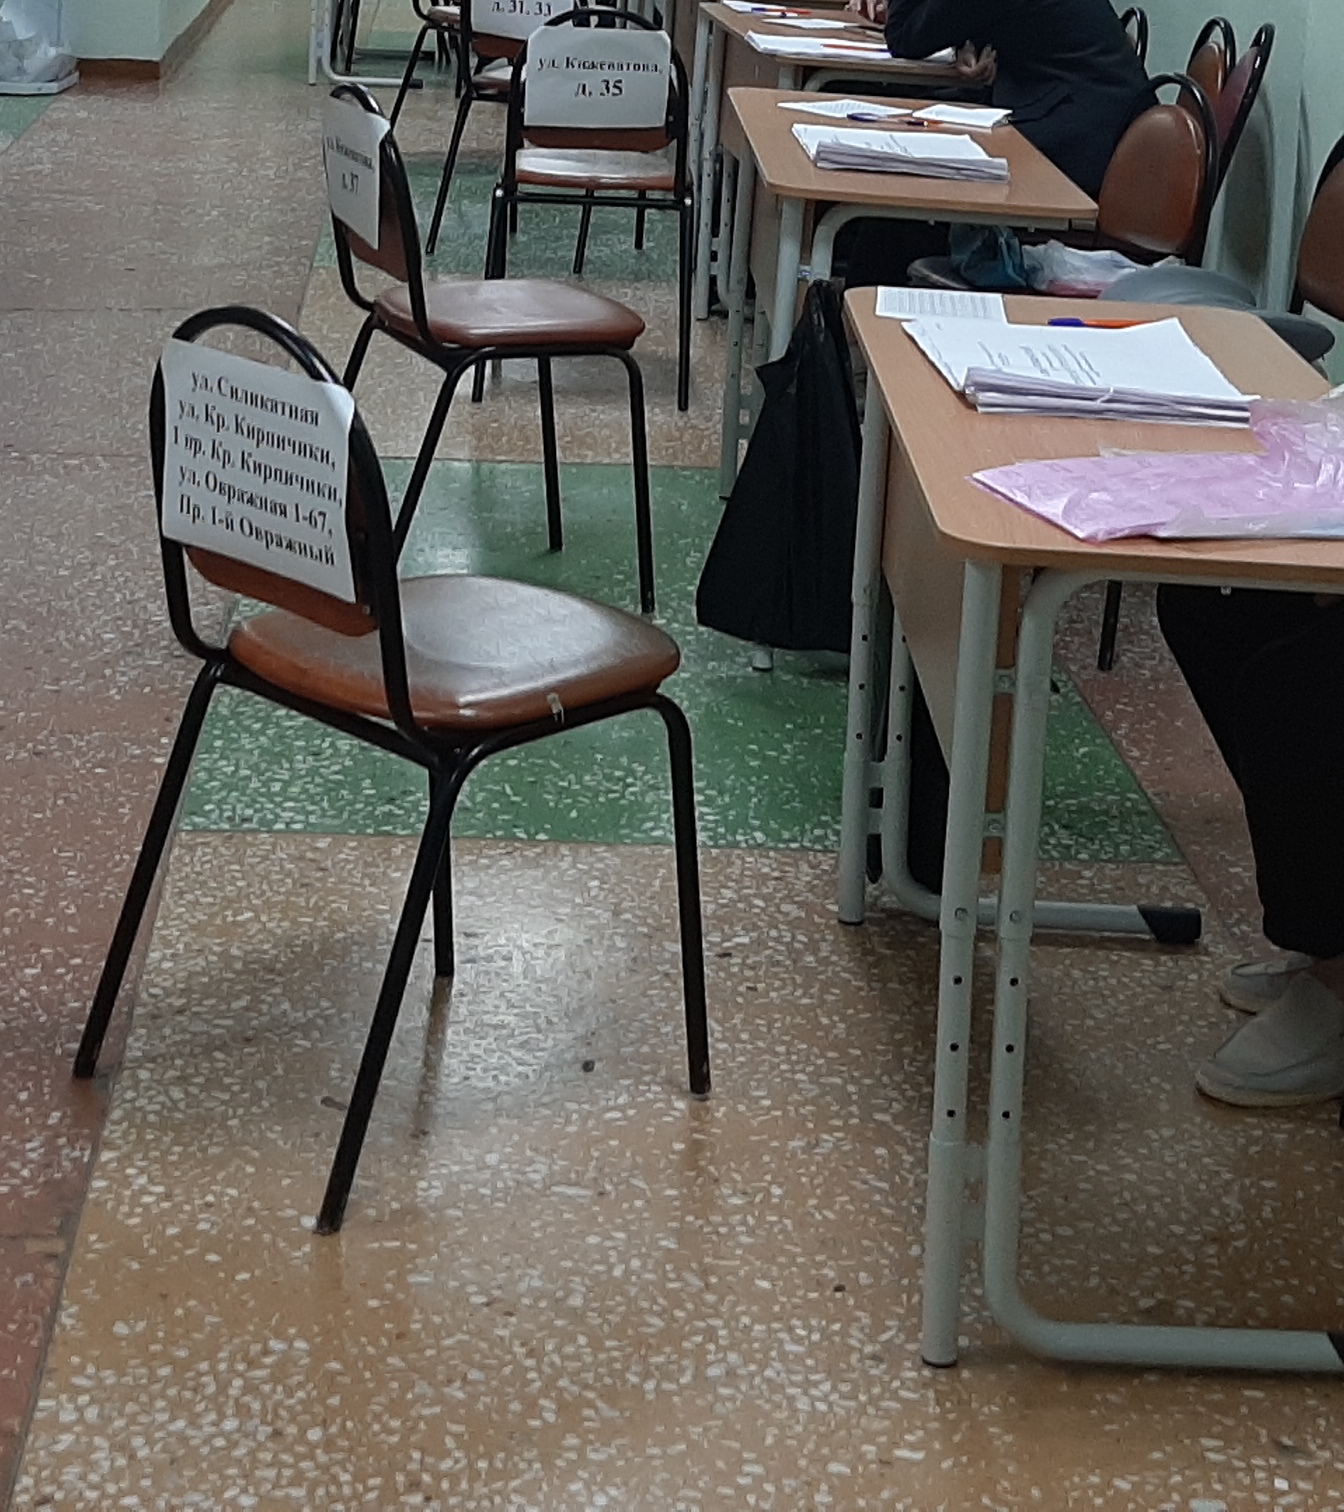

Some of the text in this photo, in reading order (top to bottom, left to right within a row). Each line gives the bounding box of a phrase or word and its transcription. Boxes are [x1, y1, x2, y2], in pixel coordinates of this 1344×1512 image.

[599, 78, 623, 97] 35
[217, 375, 320, 427] Силикатная
[204, 402, 230, 433] Кр.
[234, 412, 336, 472] Кирпичики,
[178, 464, 334, 539] ул. Овражная 1-67,
[210, 437, 235, 469] Кр.
[240, 450, 343, 508] Кирпичики,
[179, 493, 335, 567] Пр. 1-й Овражный
